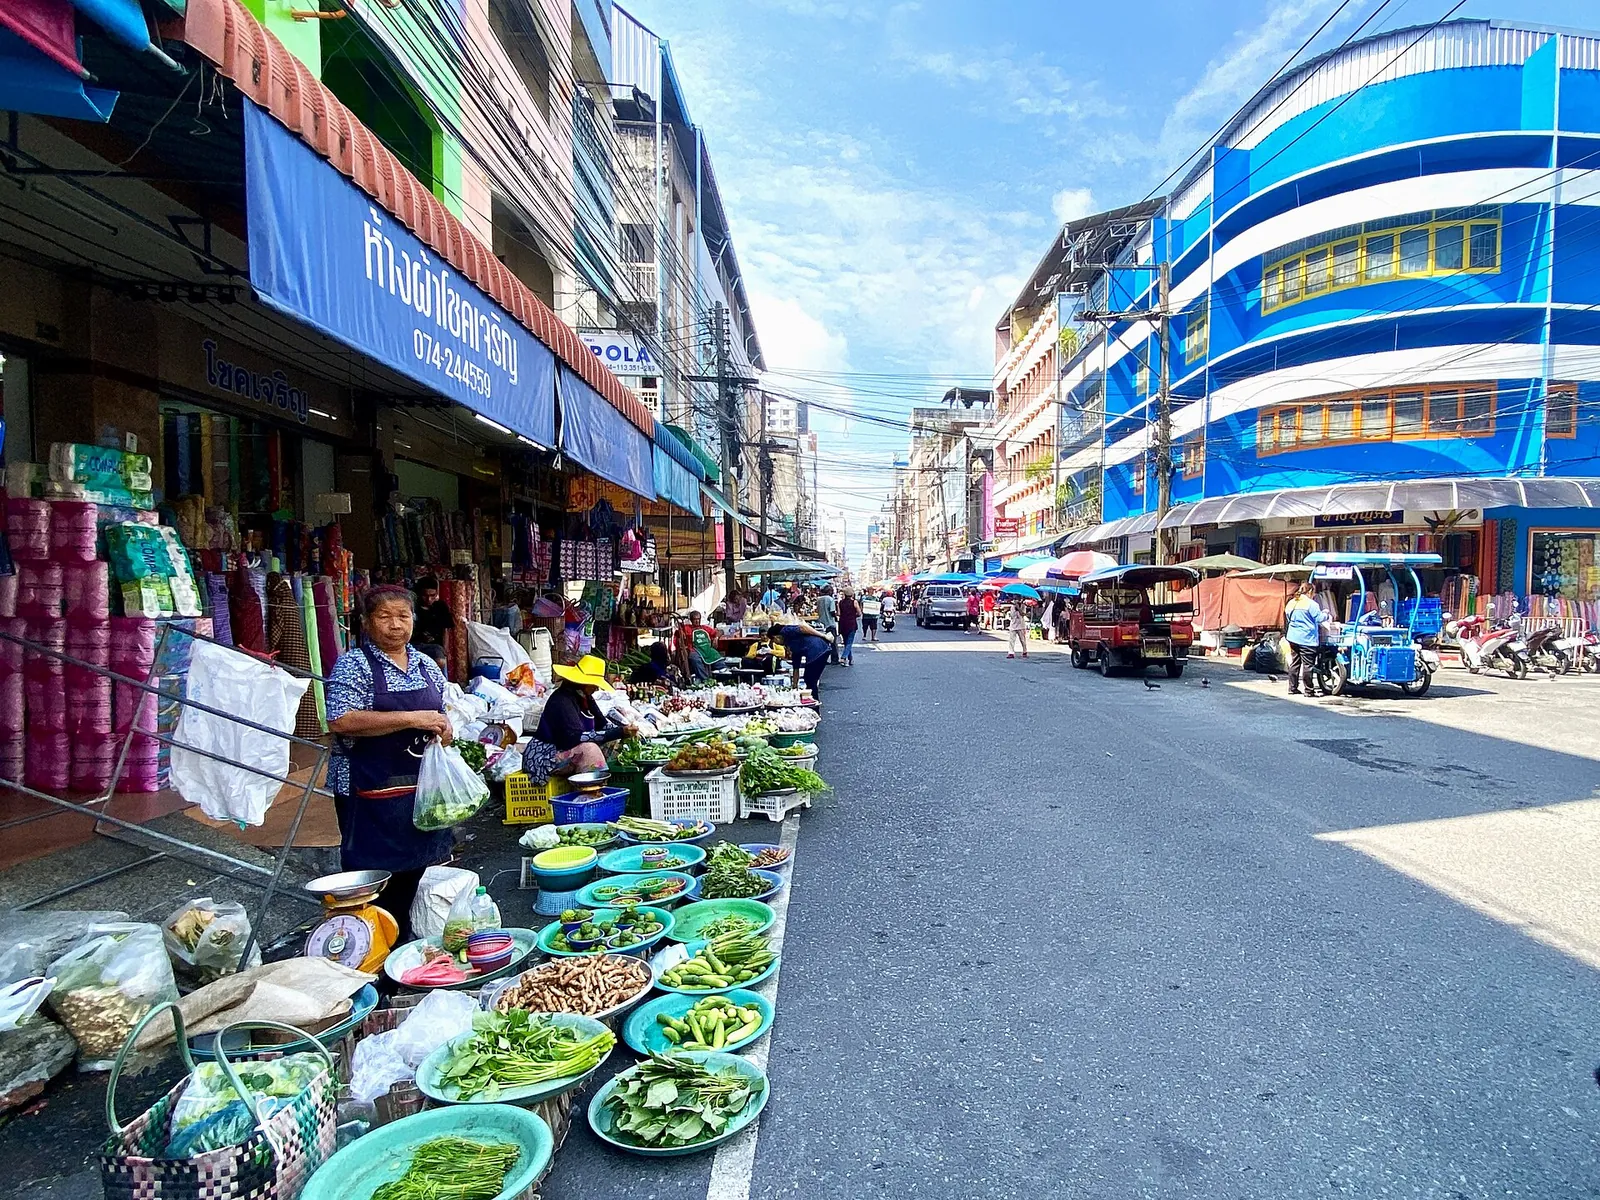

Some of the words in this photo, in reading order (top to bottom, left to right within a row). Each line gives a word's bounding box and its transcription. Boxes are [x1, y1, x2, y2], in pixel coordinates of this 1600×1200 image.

[364, 206, 518, 386] ห้างผ้าโชคเจริญ
[203, 339, 308, 424] โชคเจริญ
[413, 328, 491, 399] 074-244559
[590, 345, 650, 362] POLA
